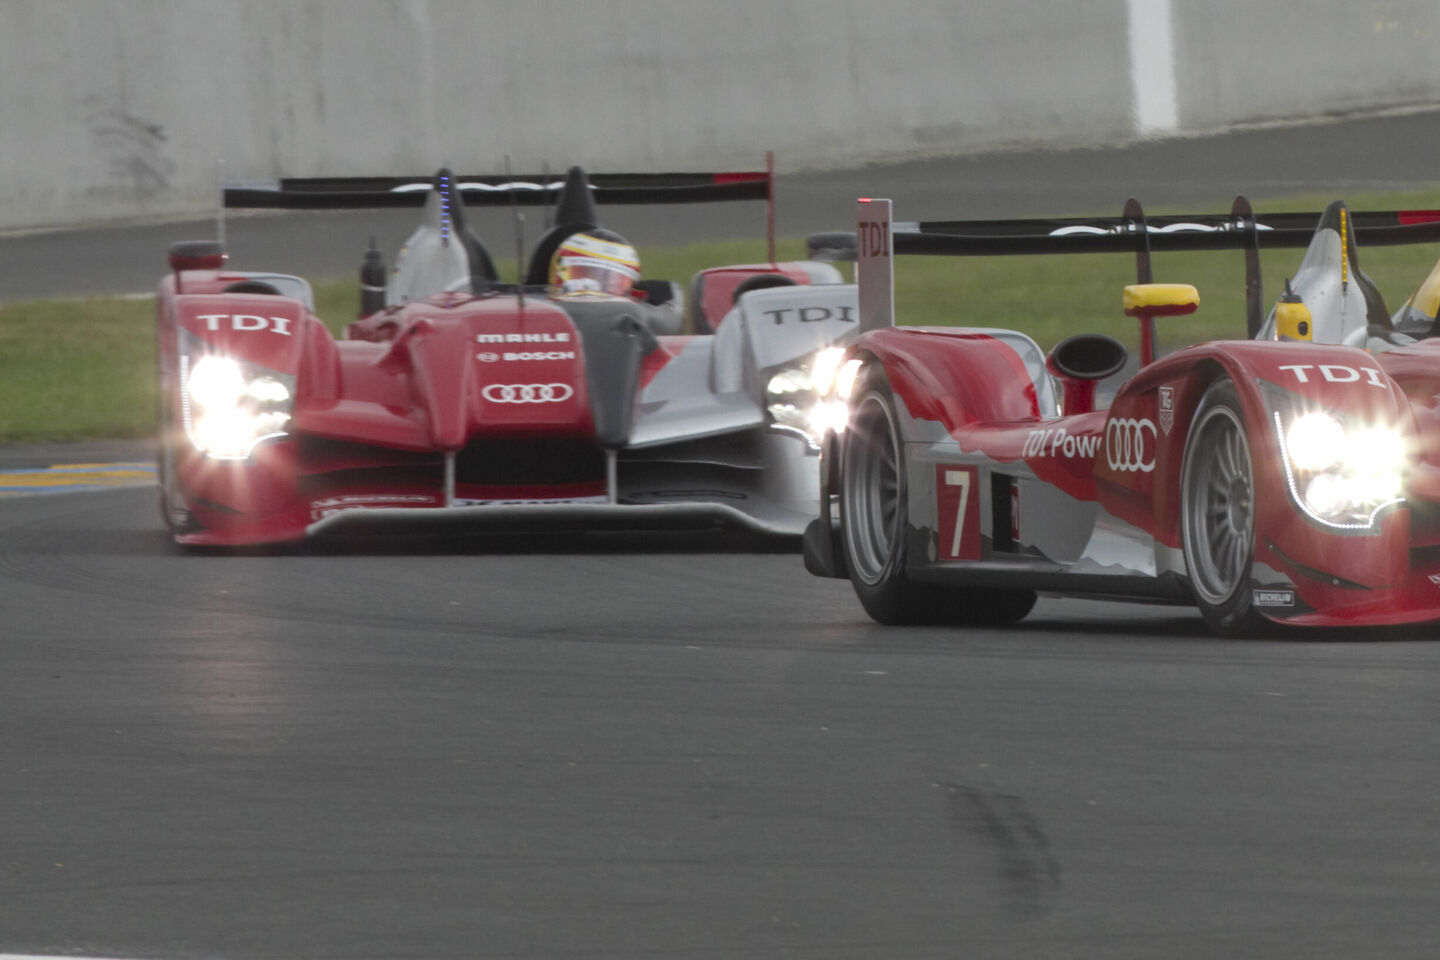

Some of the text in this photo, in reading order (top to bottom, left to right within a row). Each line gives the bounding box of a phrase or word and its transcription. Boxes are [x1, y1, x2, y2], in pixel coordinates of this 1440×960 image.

[858, 221, 889, 257] TDI
[195, 314, 292, 336] TDI
[762, 306, 857, 326] TDI
[477, 333, 570, 343] MAHLE
[503, 351, 575, 361] BOSCH
[1278, 364, 1386, 389] TDI
[1022, 428, 1102, 459] TDI Pow
[945, 470, 970, 557] 7
